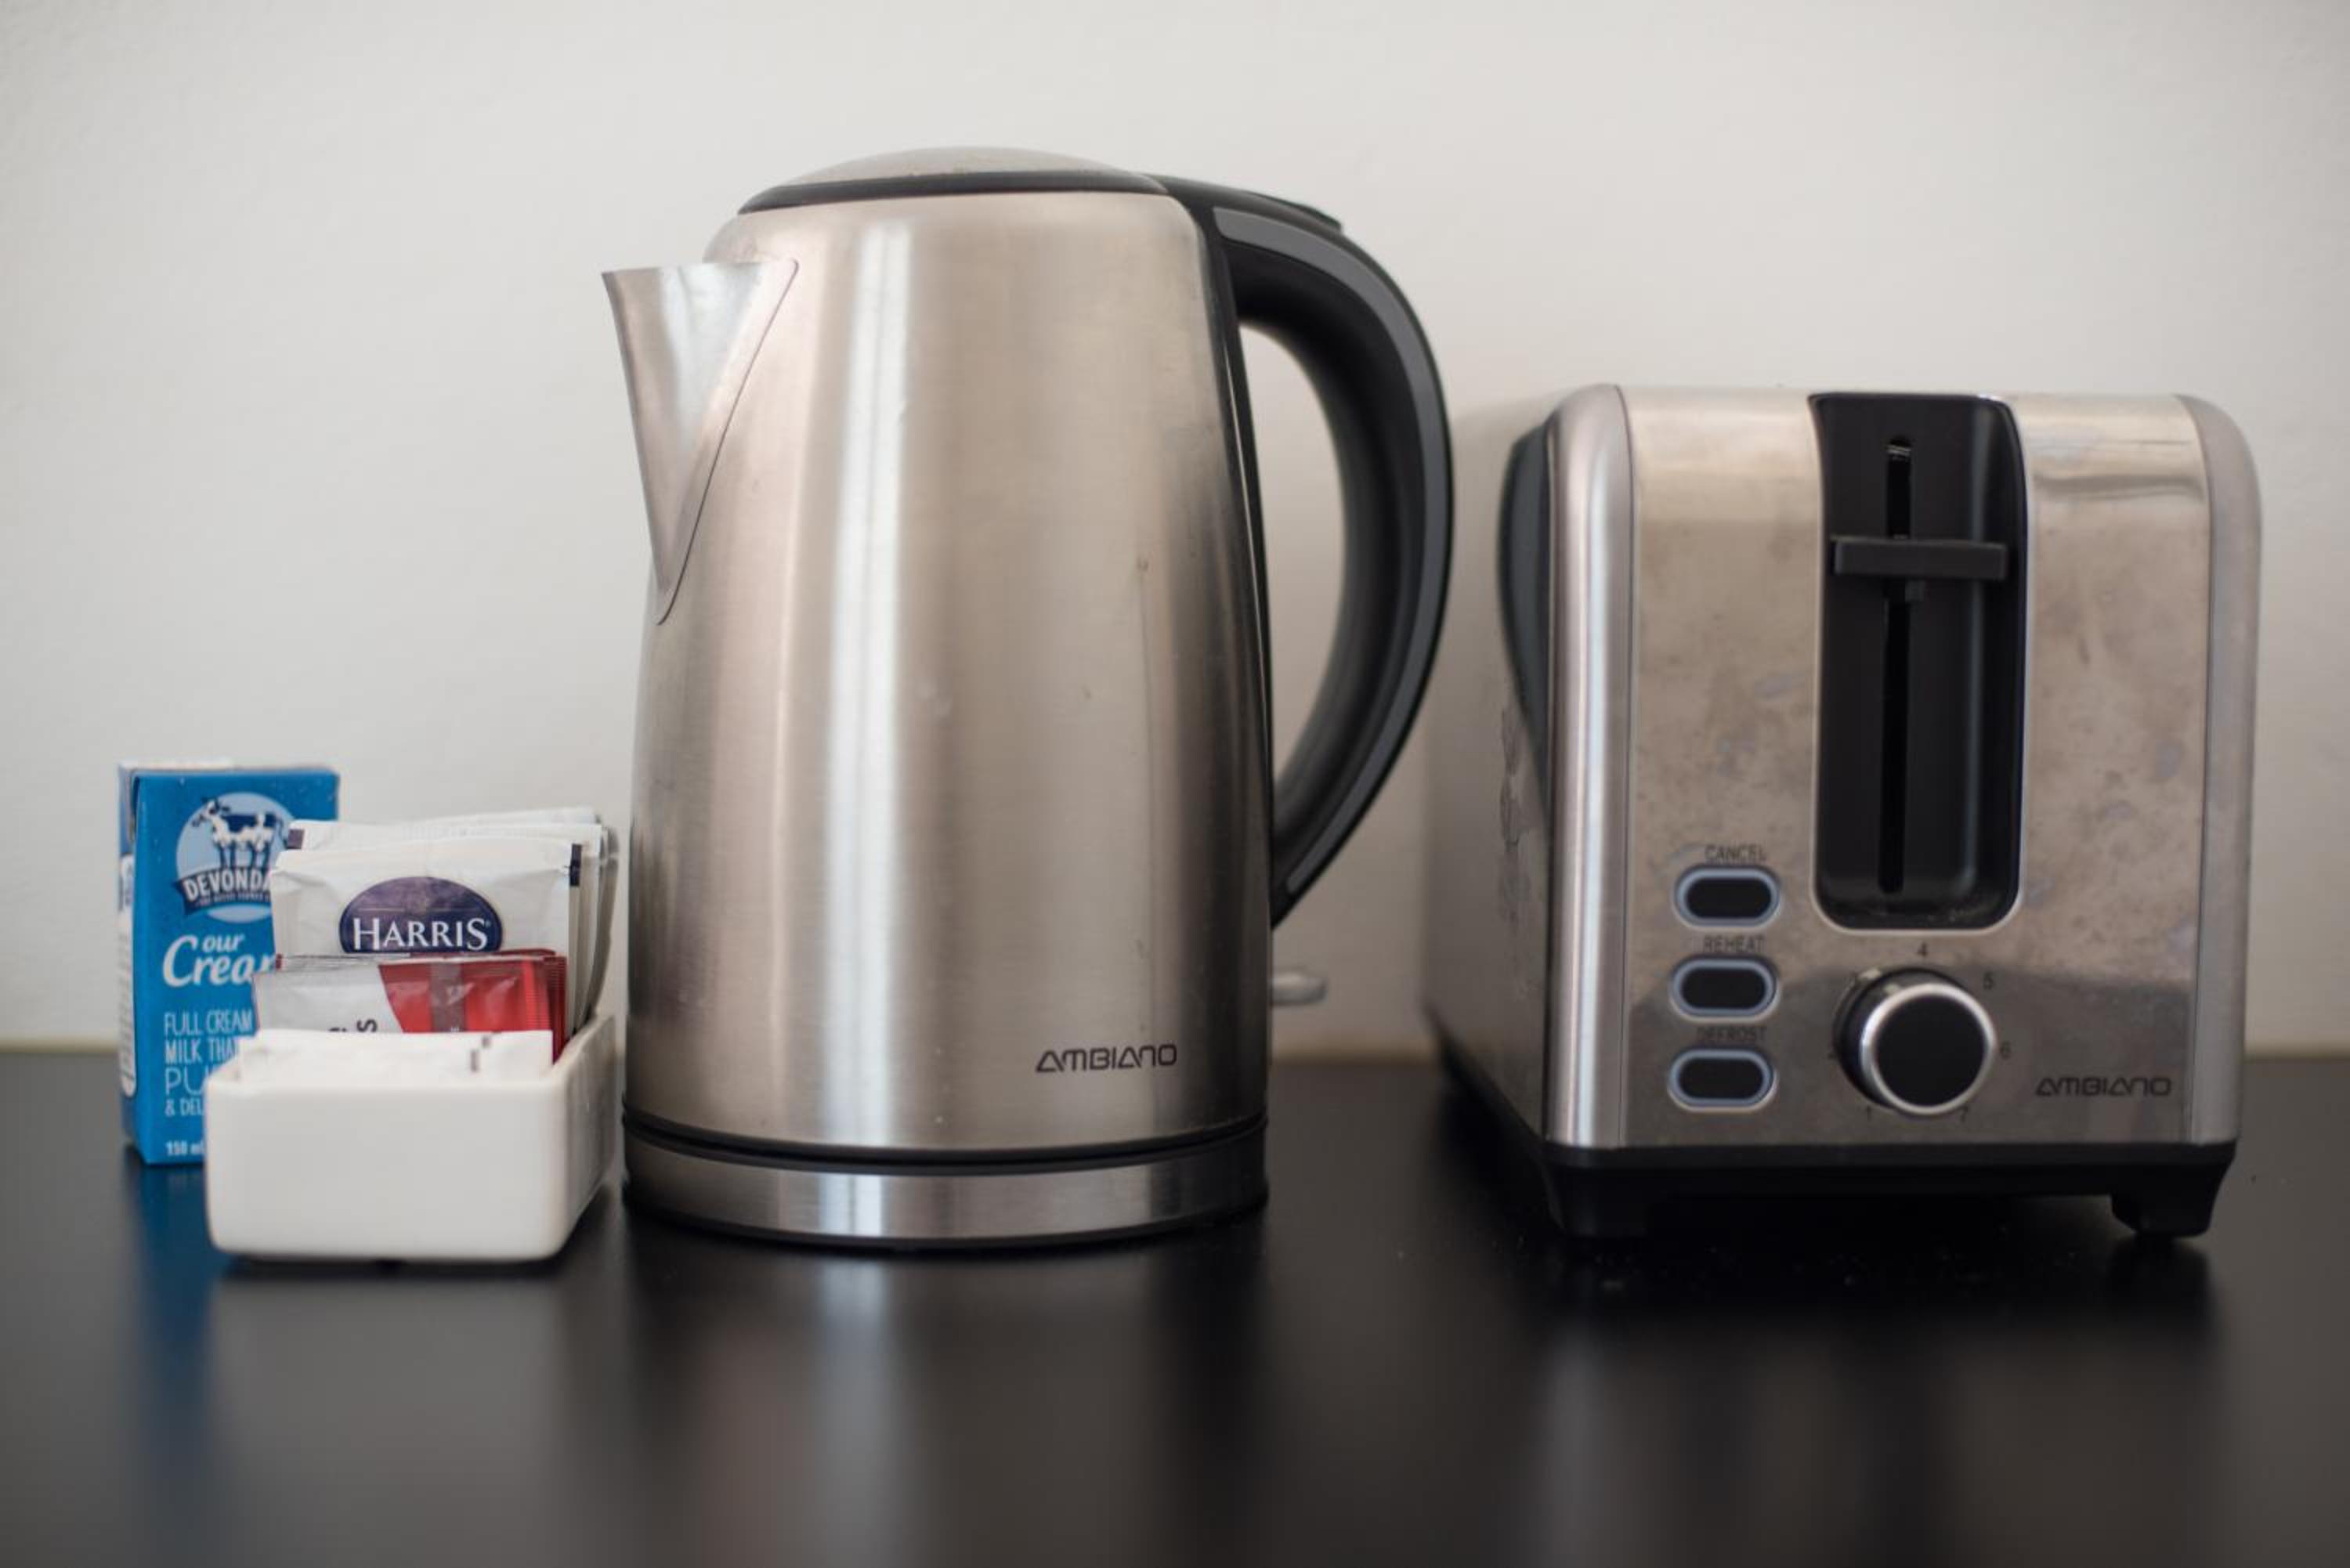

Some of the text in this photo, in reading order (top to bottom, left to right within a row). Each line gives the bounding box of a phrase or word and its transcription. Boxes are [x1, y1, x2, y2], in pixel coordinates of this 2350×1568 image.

[1705, 844, 1767, 862] CANCEL
[202, 933, 244, 952] our
[1703, 936, 1766, 953] REHEAT
[1916, 942, 1928, 958] 4
[1983, 972, 1995, 990] 5
[164, 1010, 253, 1036] FULL CREAM
[1697, 1026, 1767, 1042] DEFROST
[164, 1038, 203, 1064] MILK
[1036, 1044, 1177, 1072] AMBIANO
[2035, 1077, 2172, 1097] AMBIANO
[164, 1099, 176, 1117] &
